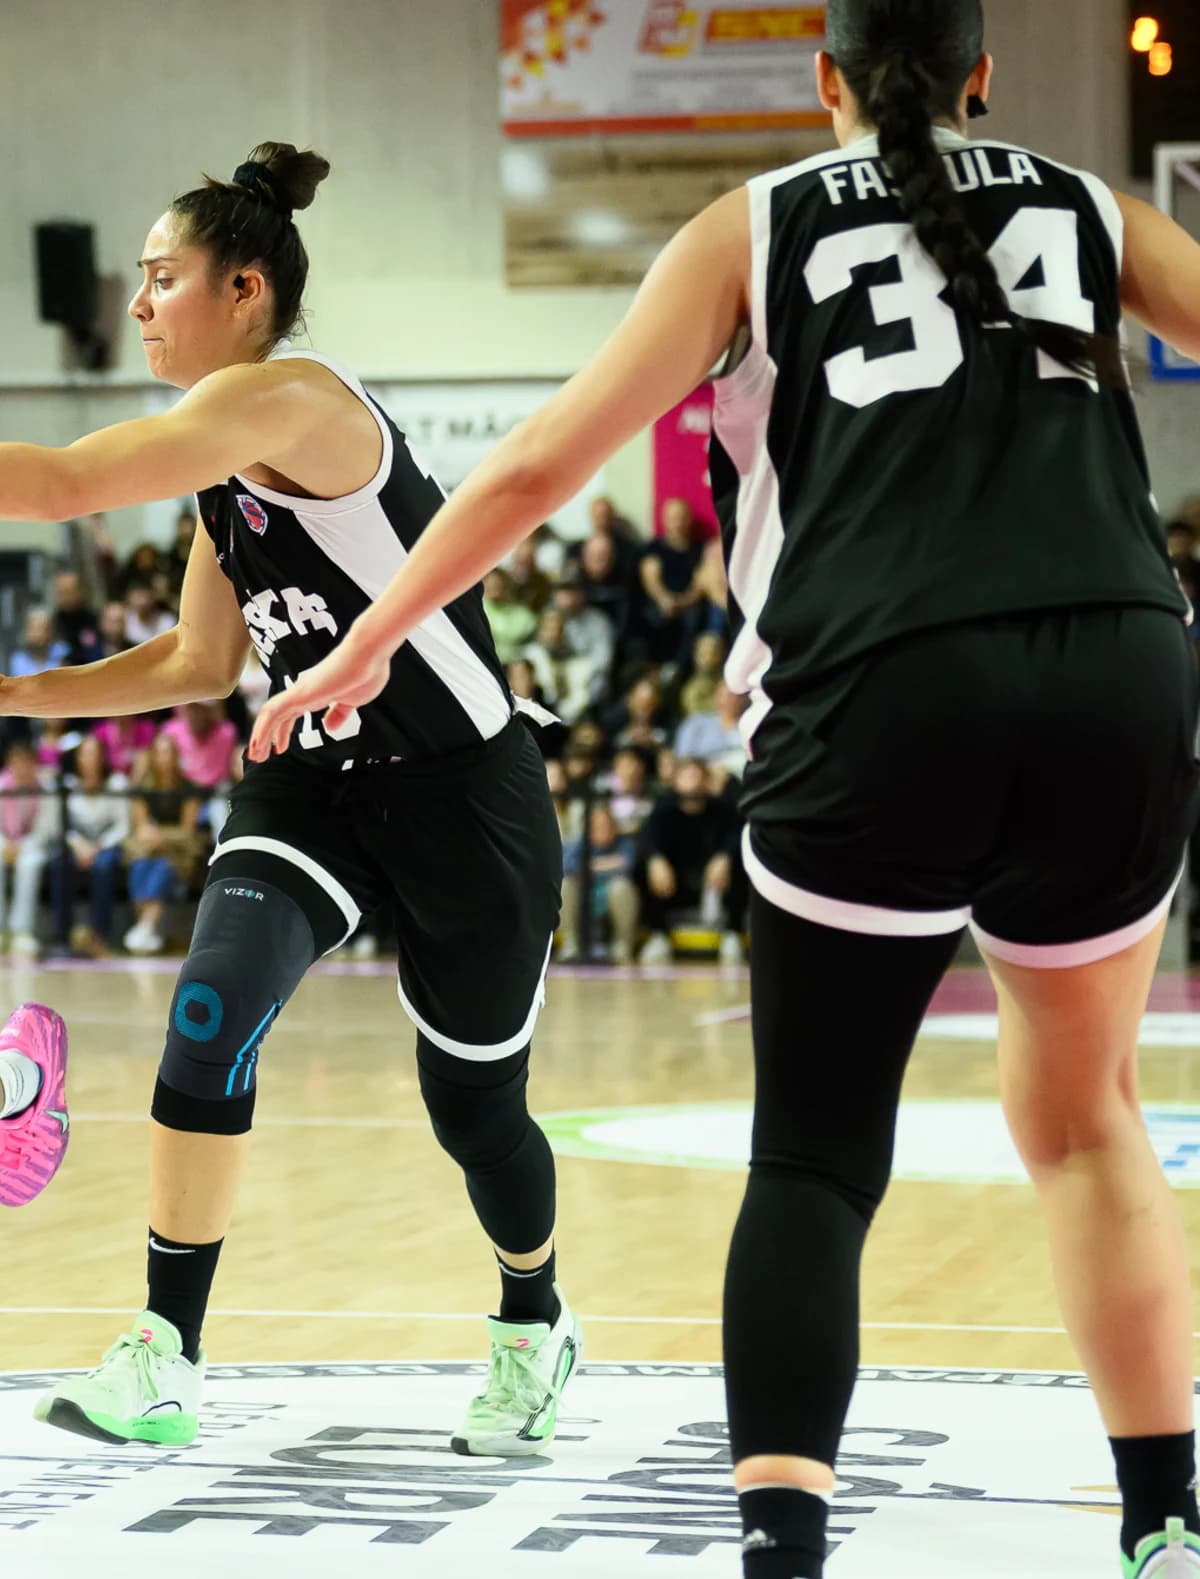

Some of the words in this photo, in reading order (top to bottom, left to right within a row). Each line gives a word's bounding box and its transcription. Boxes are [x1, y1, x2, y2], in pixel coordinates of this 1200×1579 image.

[819, 148, 1043, 205] FAULA
[803, 206, 1097, 408] 34
[224, 887, 265, 902] VIZOR
